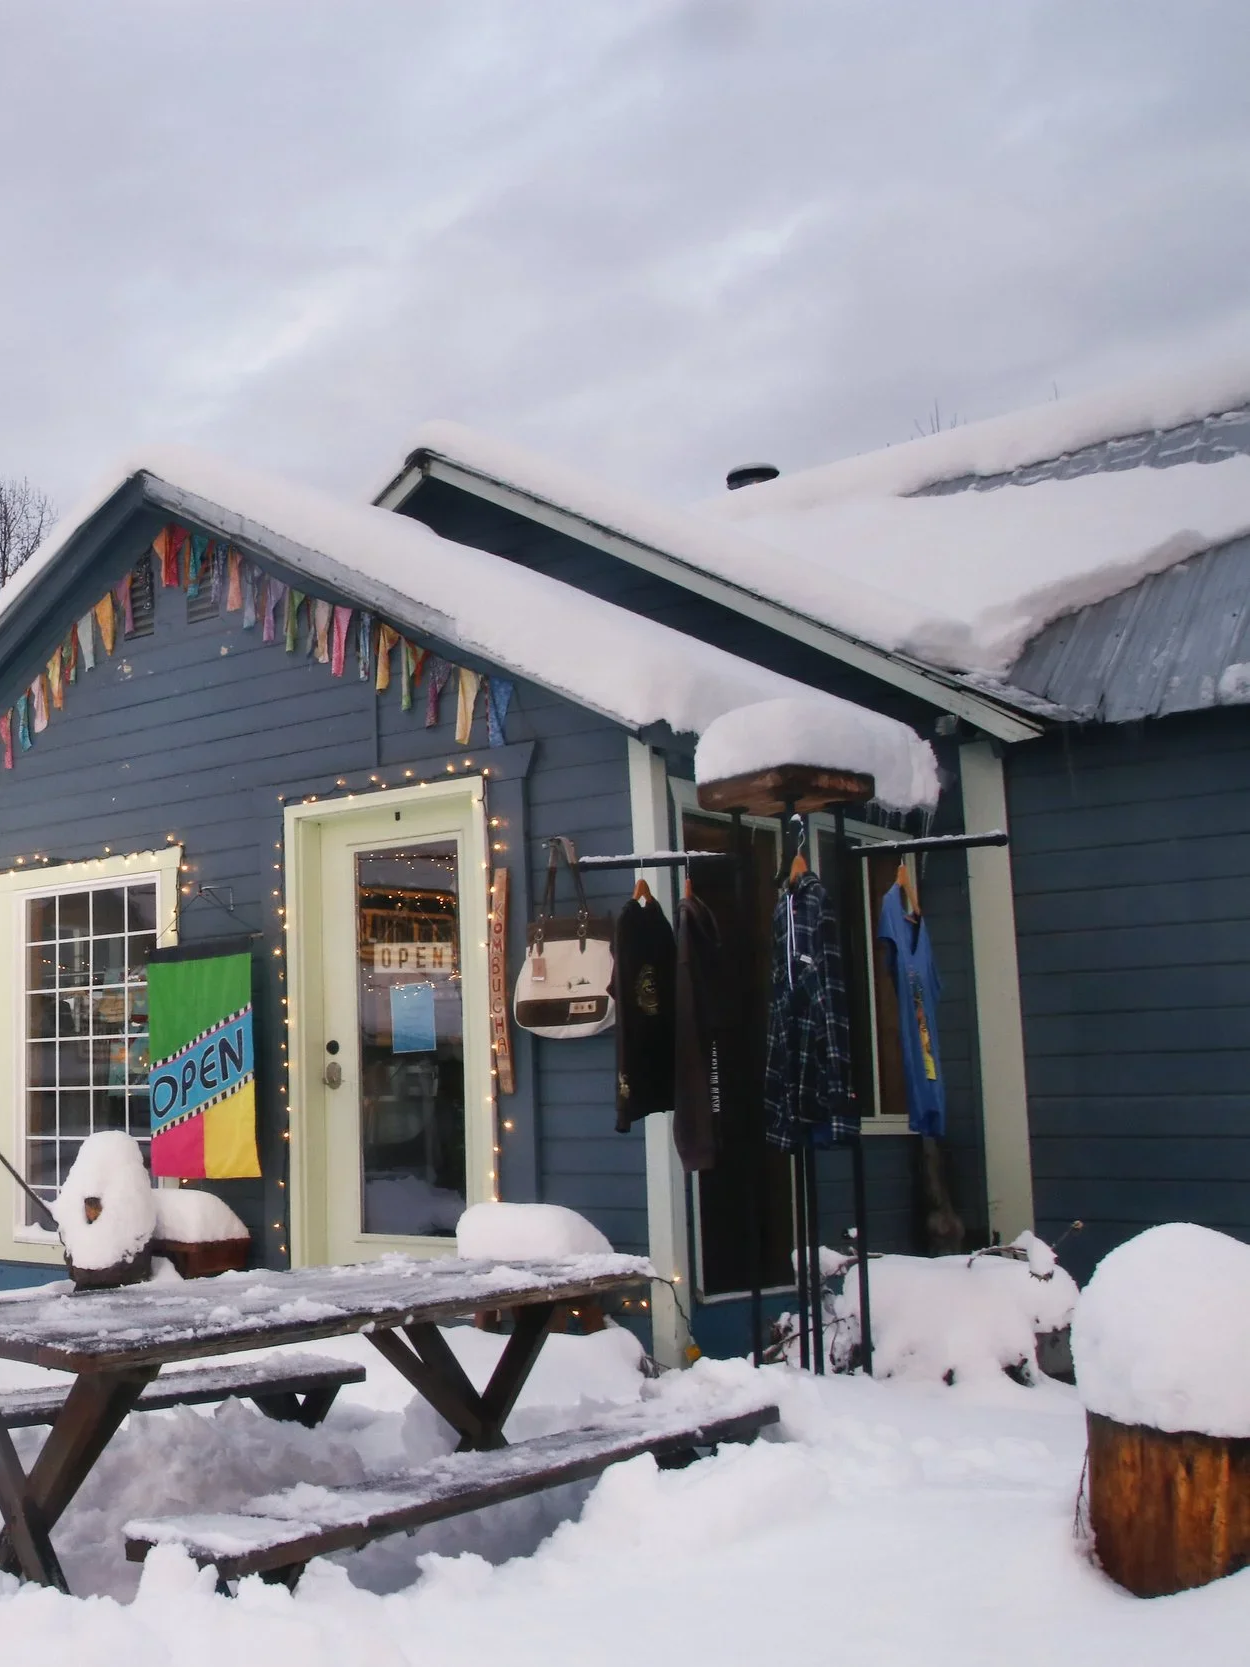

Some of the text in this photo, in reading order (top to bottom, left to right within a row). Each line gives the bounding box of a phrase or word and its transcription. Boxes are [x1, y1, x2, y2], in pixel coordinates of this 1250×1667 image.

[381, 946, 444, 969] OPEN
[491, 902, 509, 1055] KOMBUCHA
[152, 1027, 244, 1119] OPEN
